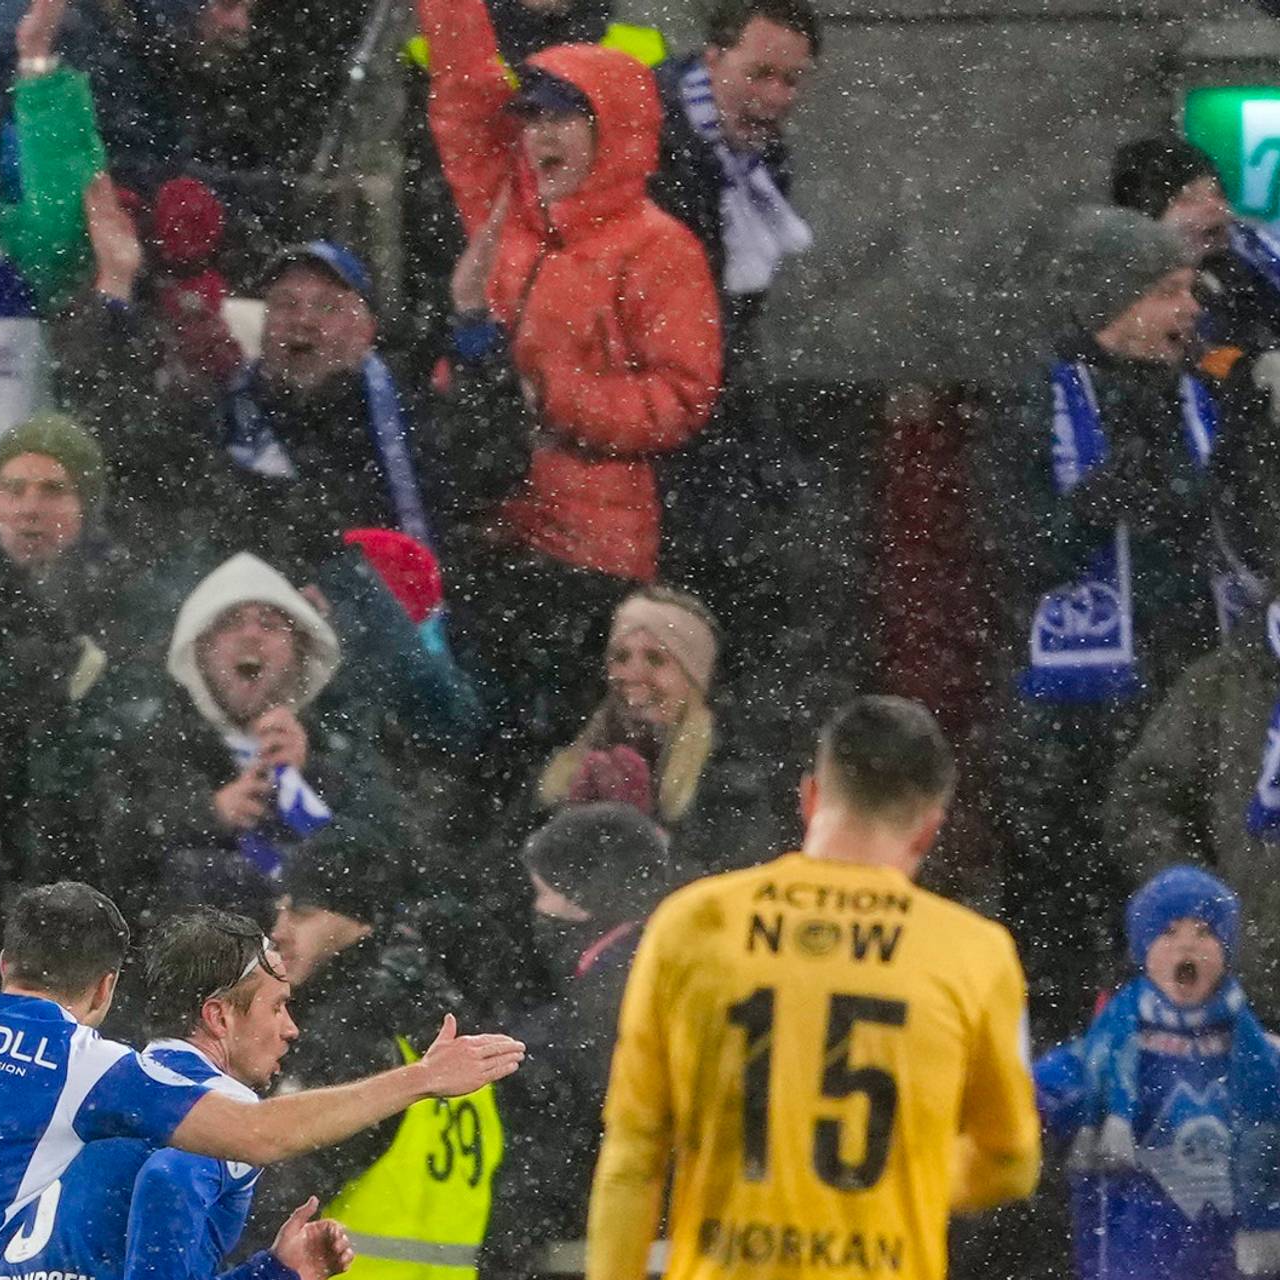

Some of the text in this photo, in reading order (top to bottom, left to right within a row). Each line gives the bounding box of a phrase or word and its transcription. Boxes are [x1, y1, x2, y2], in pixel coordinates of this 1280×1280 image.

[752, 881, 912, 916] ACTION
[727, 986, 908, 1191] 15
[426, 1097, 483, 1188] 39
